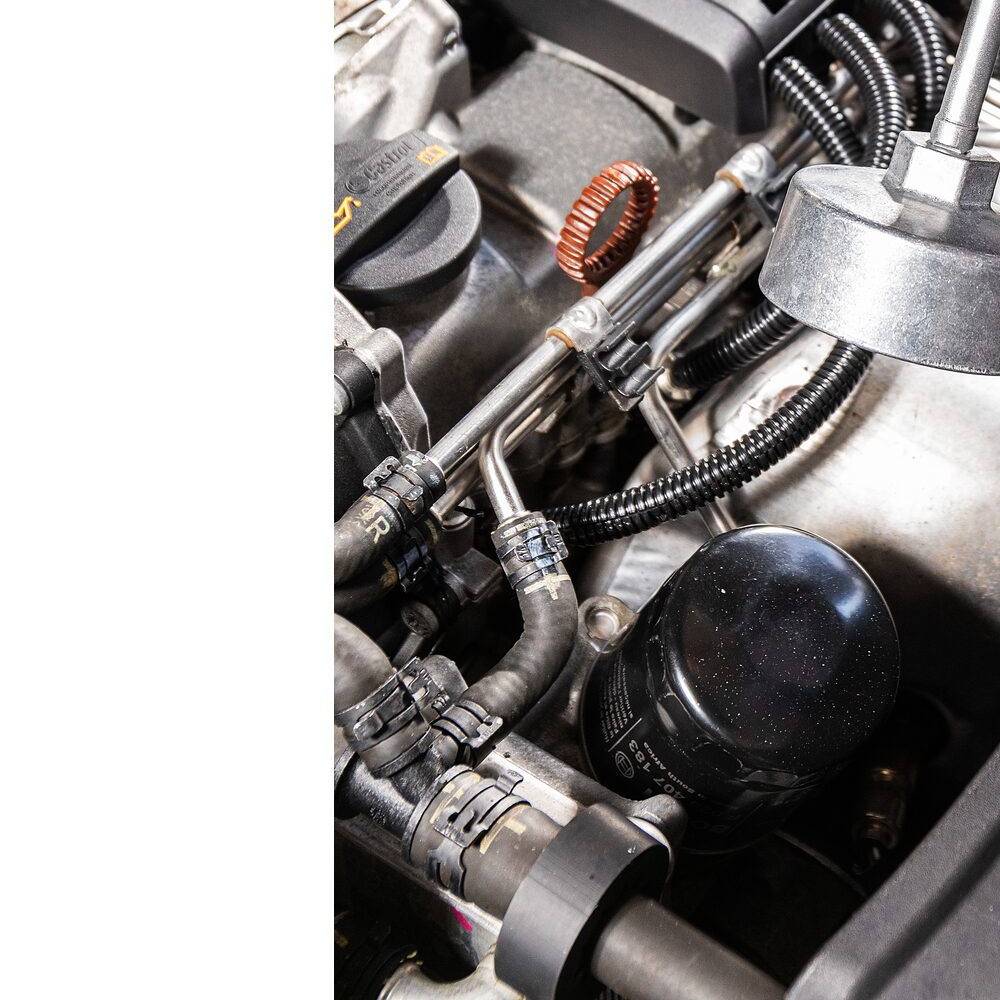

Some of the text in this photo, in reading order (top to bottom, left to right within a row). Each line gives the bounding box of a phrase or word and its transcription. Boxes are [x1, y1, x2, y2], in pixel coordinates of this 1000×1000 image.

[363, 140, 413, 181] Castrol
[628, 739, 686, 799] 407 183
[643, 741, 696, 794] South Africa
